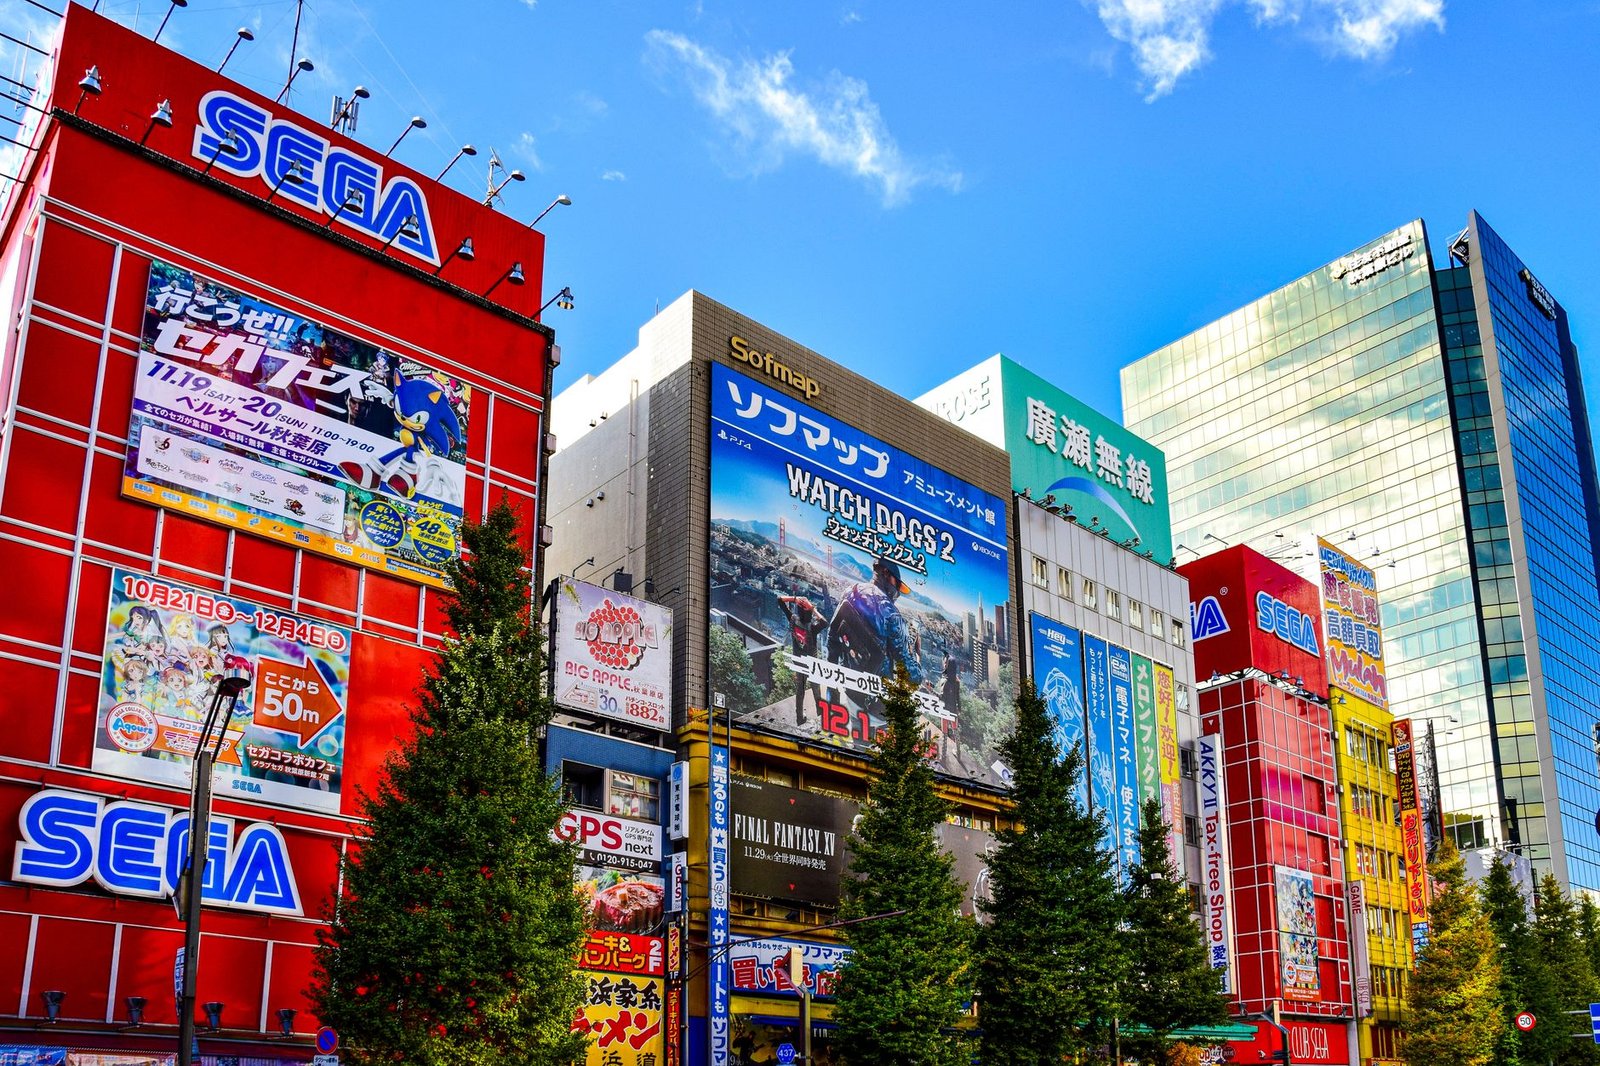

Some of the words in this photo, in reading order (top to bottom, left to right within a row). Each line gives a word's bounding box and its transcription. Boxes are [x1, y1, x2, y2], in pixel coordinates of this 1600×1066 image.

[192, 90, 441, 268] SEGA
[147, 360, 212, 393] 11.19
[154, 318, 372, 400] セガフェス
[730, 335, 821, 400] Sofmap
[176, 395, 332, 457] ベルサール秋葉原
[729, 435, 753, 451] PS4
[726, 379, 891, 479] ソフマップ
[903, 469, 996, 526] アミューズメント館
[1025, 396, 1155, 505] 廣瀬無線
[786, 463, 878, 533] WATCH
[876, 504, 938, 555] DOGS
[939, 531, 956, 564] 2
[574, 620, 600, 642] BIG
[601, 621, 659, 649] APPLE
[1256, 590, 1321, 659] SEGA
[1326, 608, 1381, 658] 高額買取
[264, 671, 320, 695] ここから
[565, 660, 590, 679] BIG
[112, 717, 154, 735] Aqours
[262, 687, 320, 725] 50m
[246, 743, 337, 773] セガコラボカフェ
[1200, 741, 1217, 797] AKKY
[232, 779, 262, 794] SEGA
[712, 764, 728, 826] 売るのも
[12, 789, 304, 916] SEGA
[553, 812, 623, 850] GPS
[624, 825, 655, 837] リアルタイム
[624, 842, 654, 856] next
[734, 813, 770, 845] FINAL
[823, 831, 836, 857] XV
[1205, 810, 1222, 892] Tax-free
[712, 847, 727, 907] 買うのも
[1210, 893, 1224, 943] Shop
[1350, 885, 1362, 915] GAME
[669, 927, 679, 971] ラーメン
[711, 928, 728, 1014] サポートも
[1291, 1026, 1310, 1059] CLUB
[1310, 1027, 1330, 1060] SEGA
[1519, 1016, 1532, 1026] 50
[778, 1048, 794, 1058] 437
